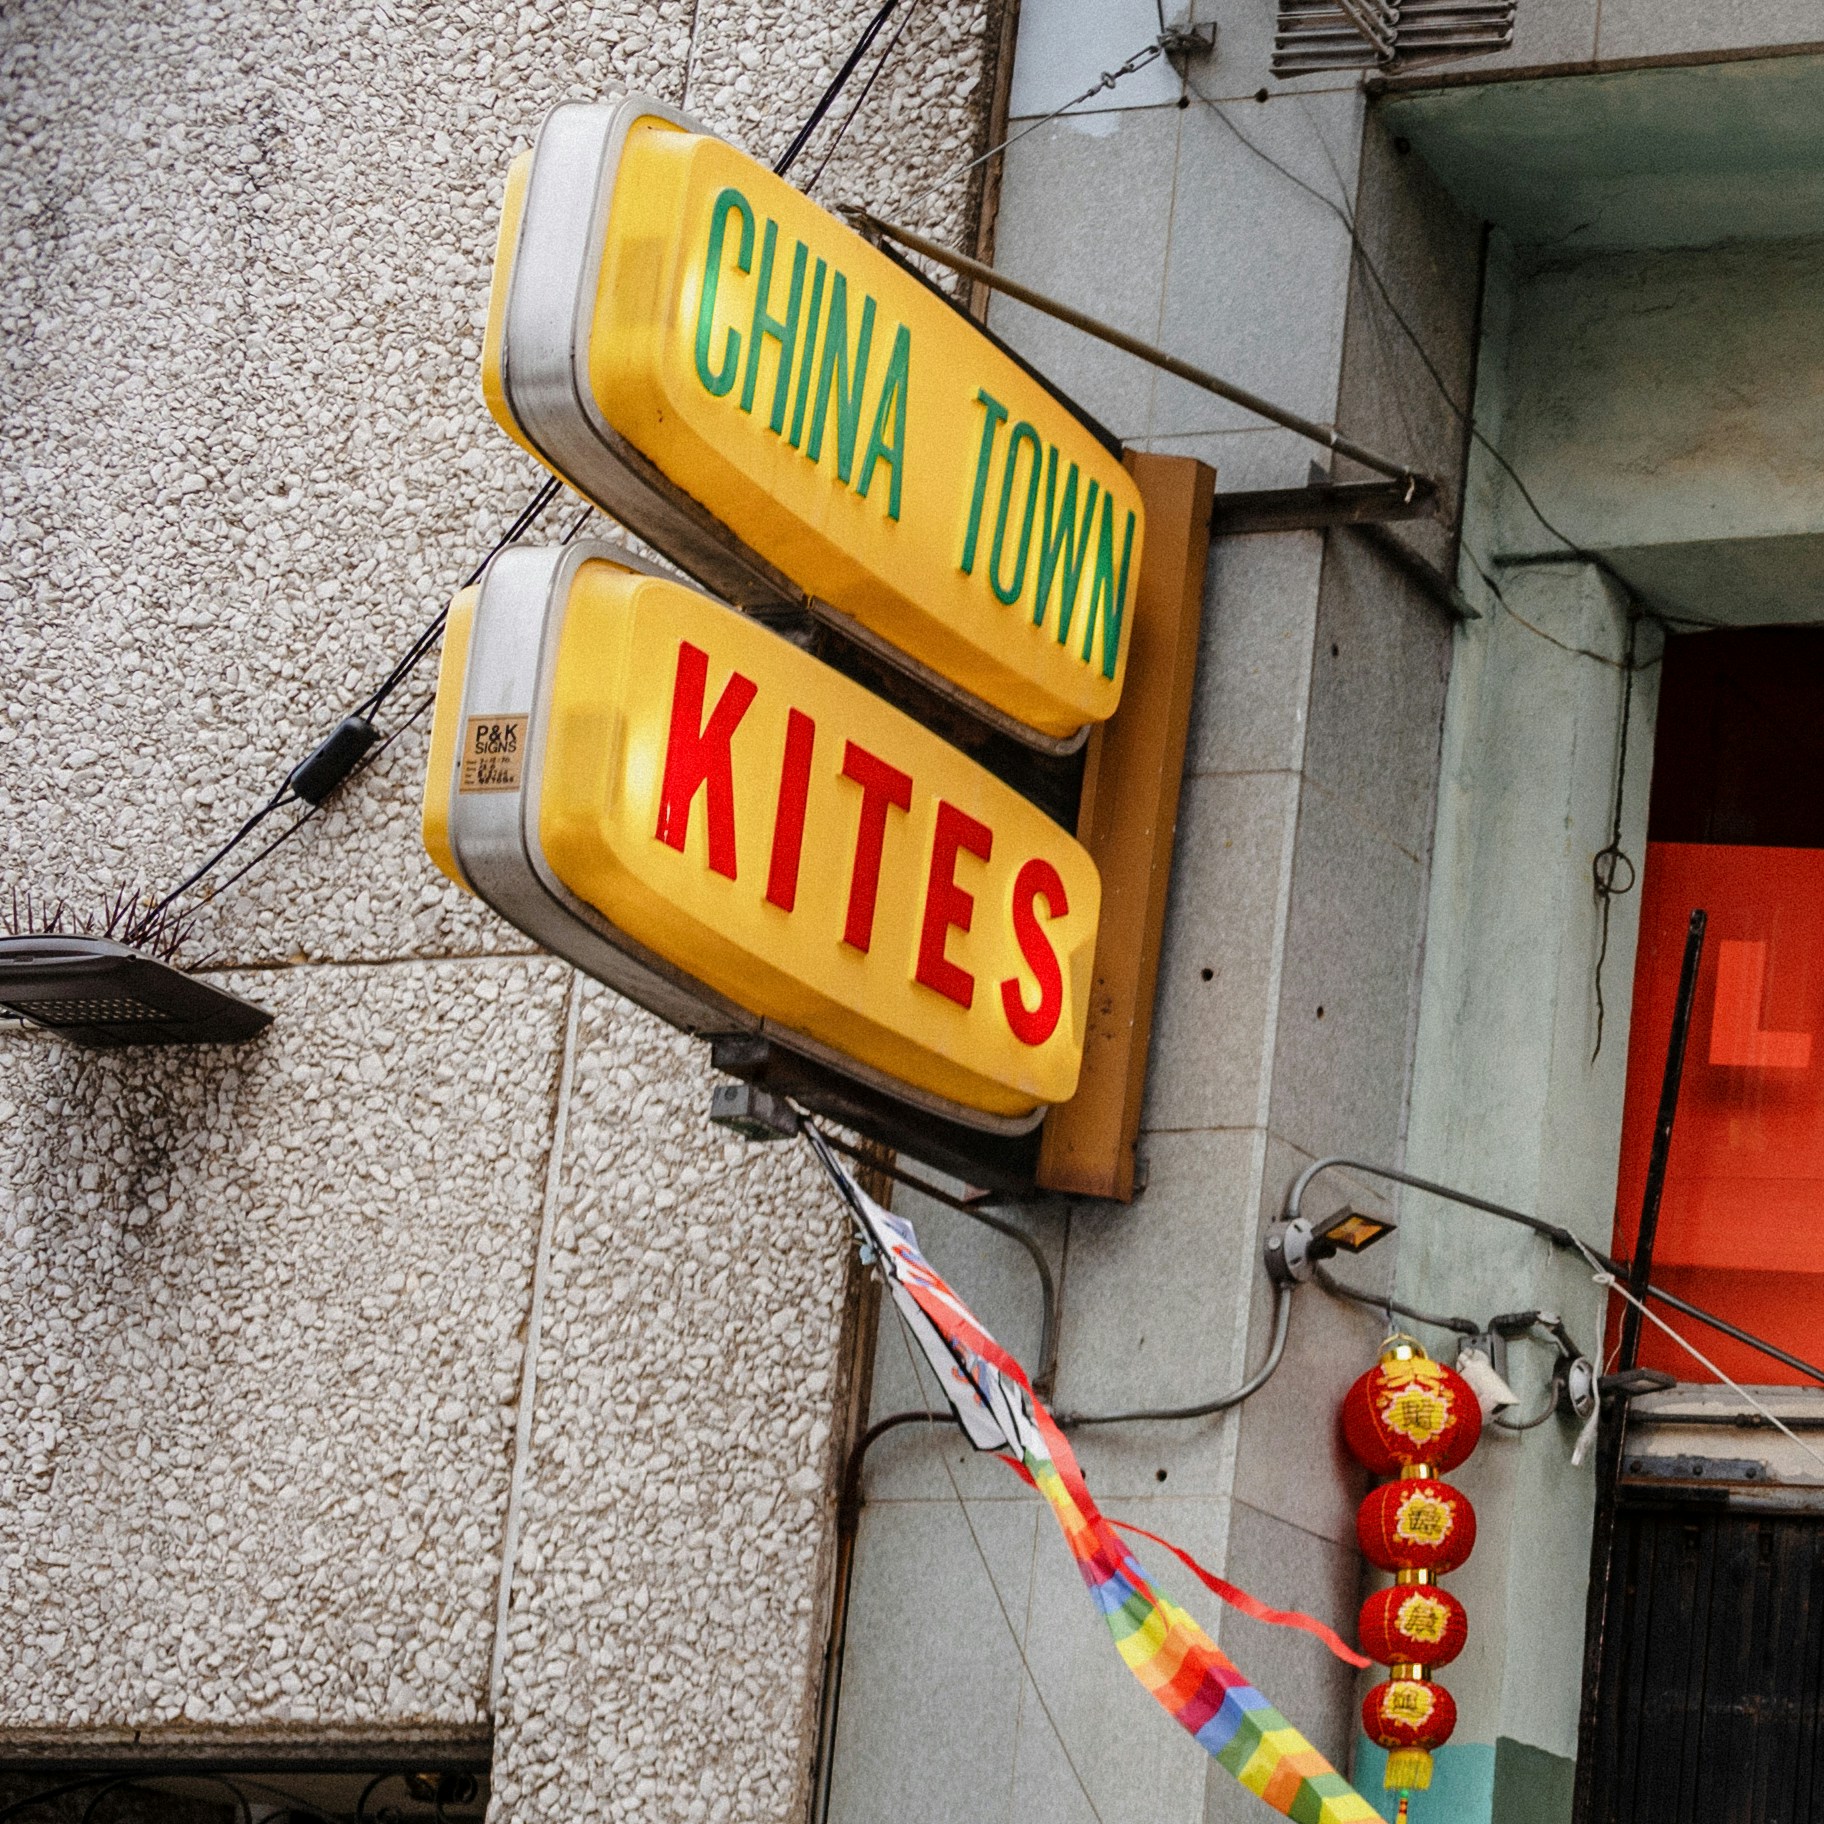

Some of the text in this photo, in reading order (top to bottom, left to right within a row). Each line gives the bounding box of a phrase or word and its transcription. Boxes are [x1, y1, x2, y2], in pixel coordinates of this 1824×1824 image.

[695, 187, 1137, 682] CHINA TOWN
[475, 723, 518, 742] P&K
[475, 740, 517, 754] SIGNS
[655, 640, 1069, 1047] KITES
